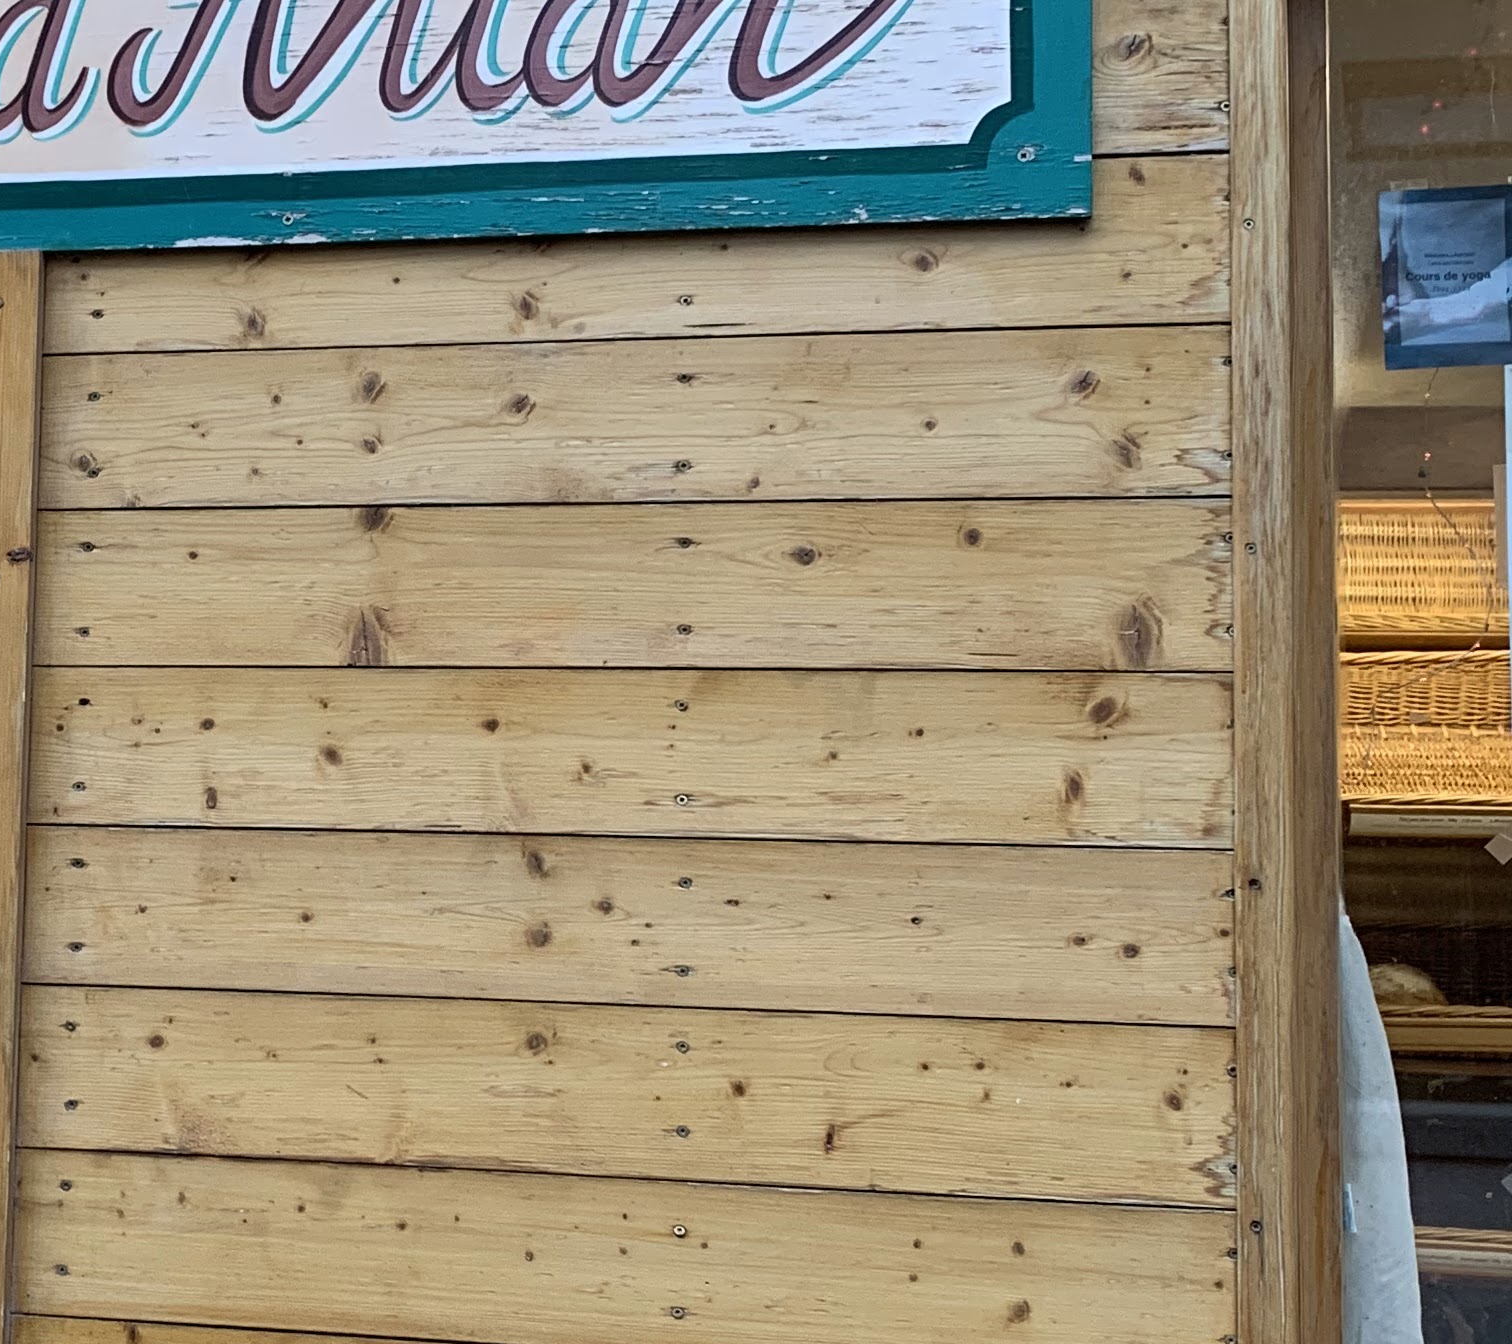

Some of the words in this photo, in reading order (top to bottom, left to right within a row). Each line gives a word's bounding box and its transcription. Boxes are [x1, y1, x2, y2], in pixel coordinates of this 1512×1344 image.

[1406, 272, 1440, 281] Cours
[1443, 271, 1458, 281] de
[1462, 271, 1491, 282] yoga
